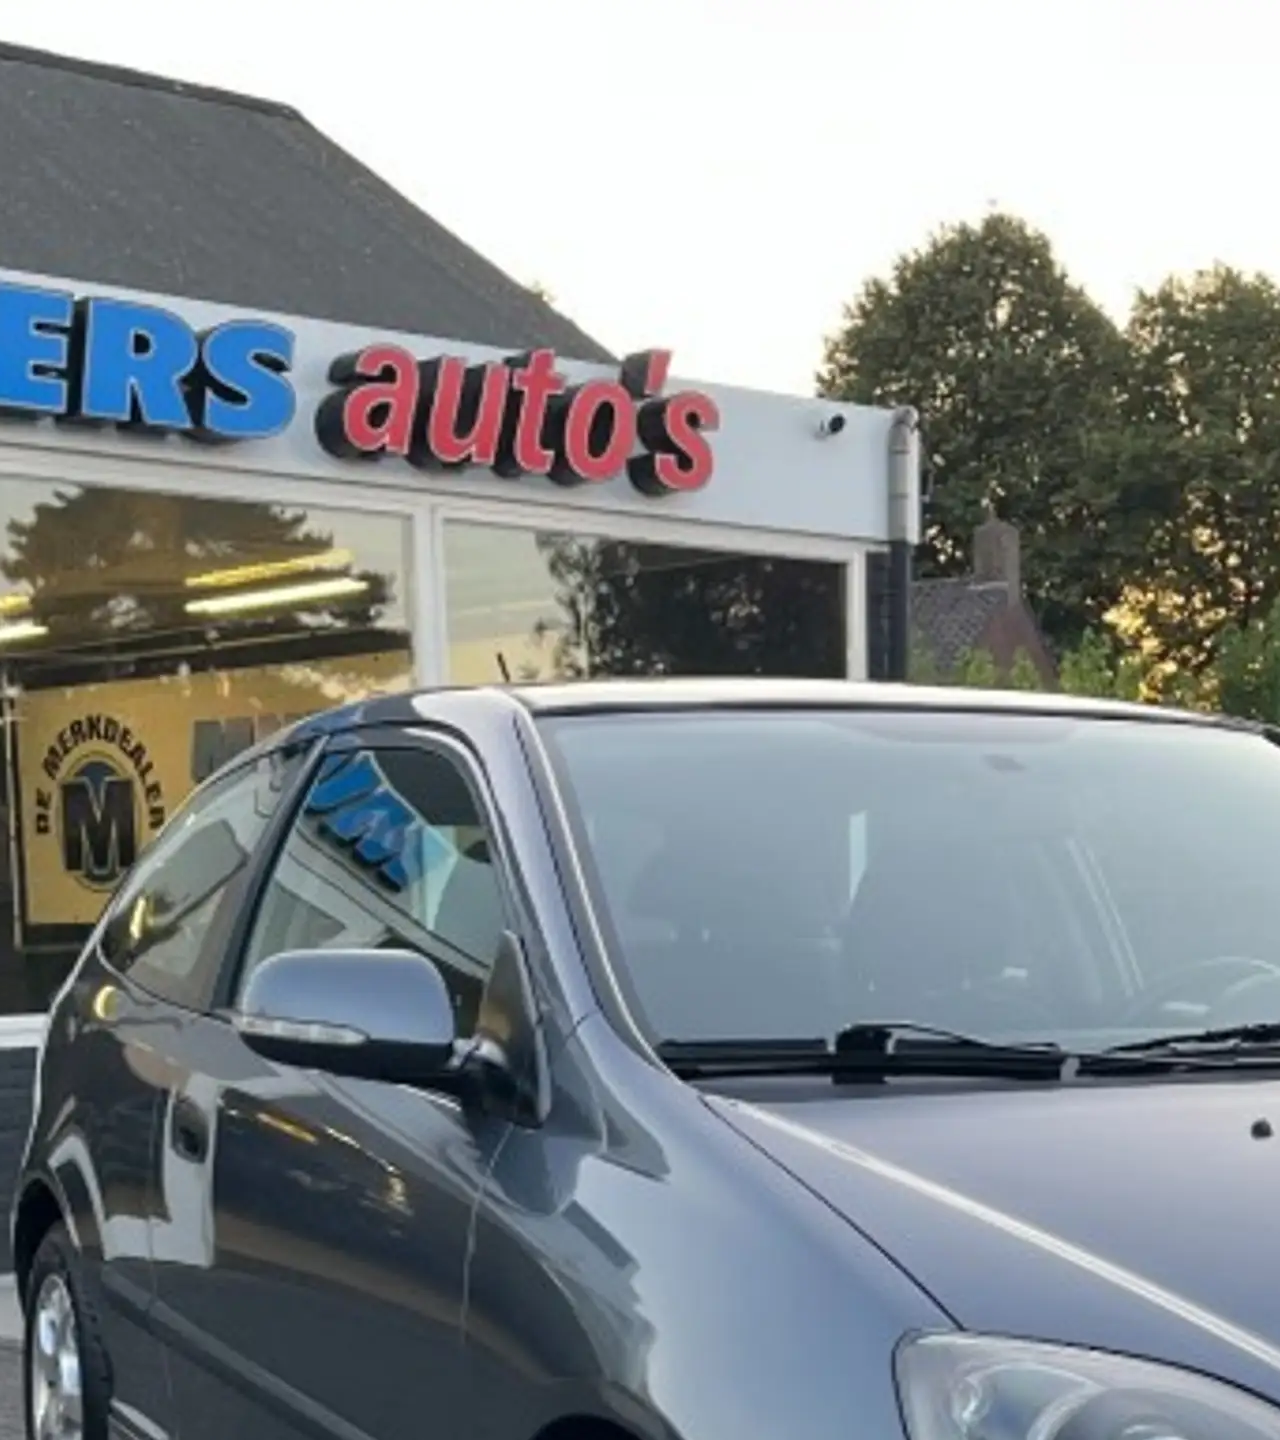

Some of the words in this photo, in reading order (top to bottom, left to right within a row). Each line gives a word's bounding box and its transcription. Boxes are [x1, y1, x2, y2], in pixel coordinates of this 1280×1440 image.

[328, 342, 721, 493] auto's
[35, 787, 52, 835] DE
[59, 774, 138, 877] M
